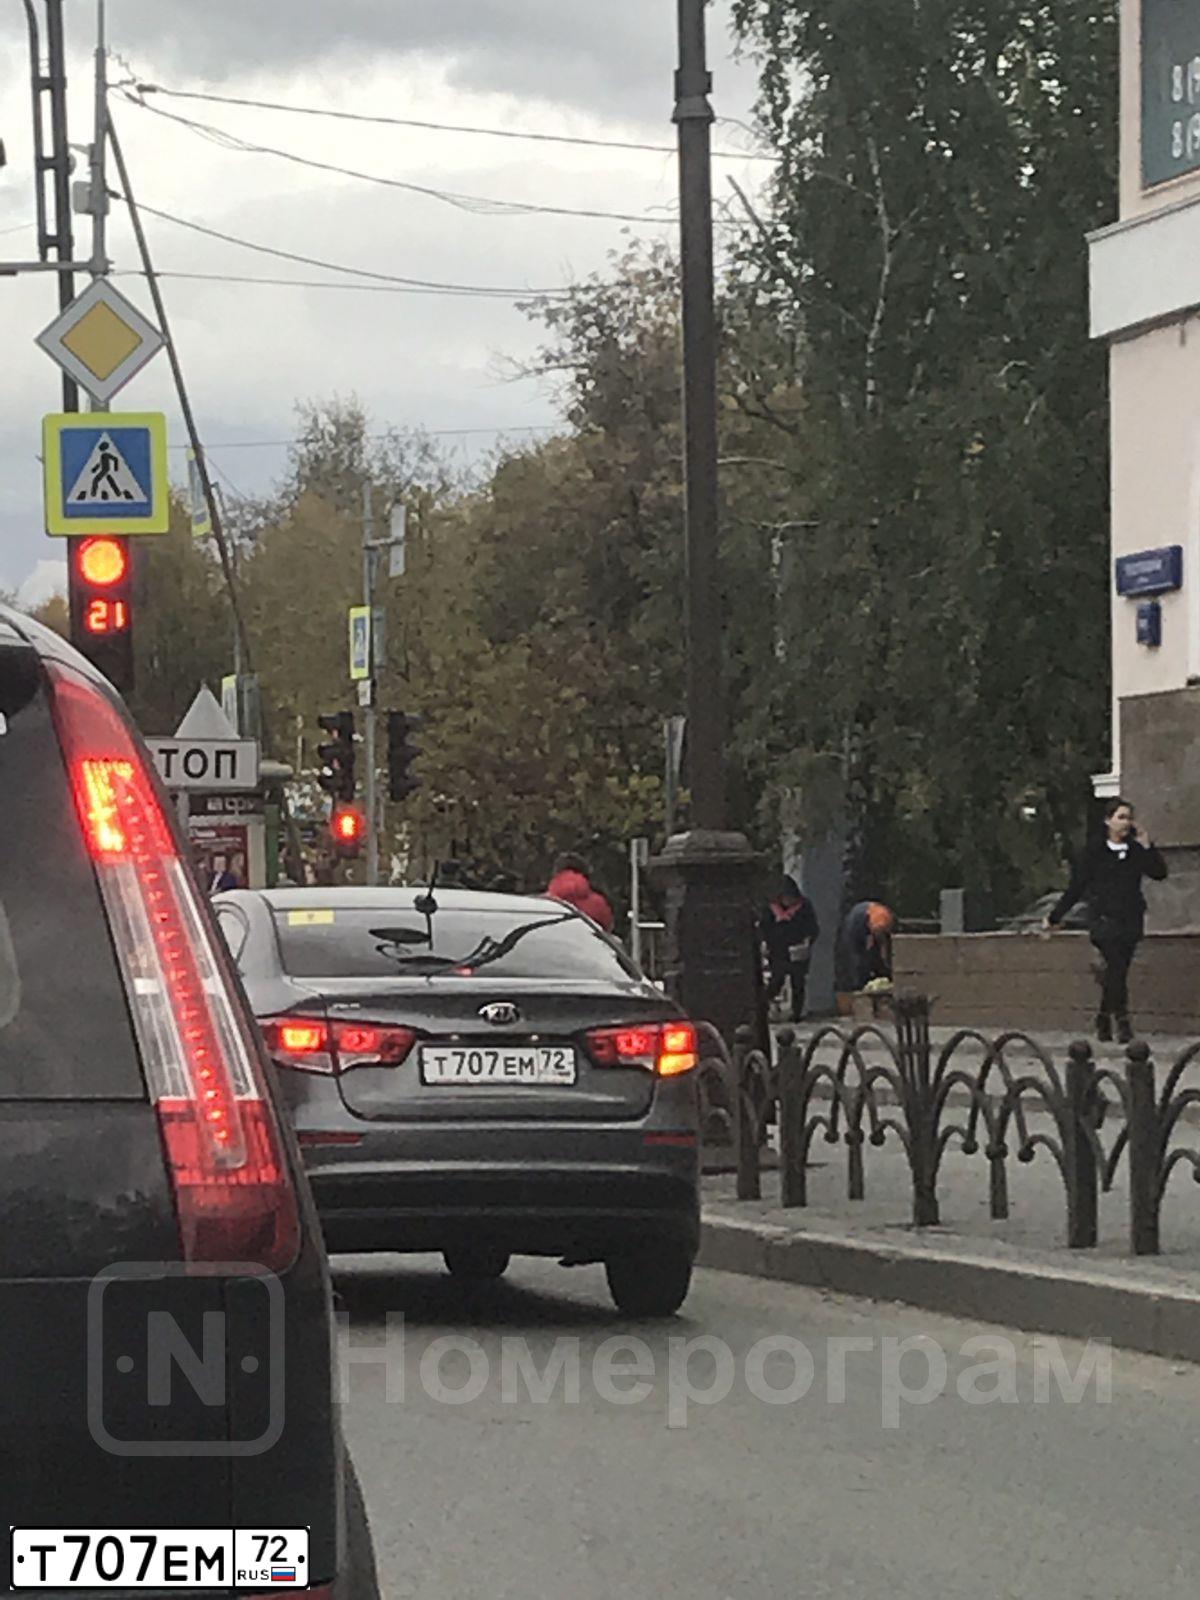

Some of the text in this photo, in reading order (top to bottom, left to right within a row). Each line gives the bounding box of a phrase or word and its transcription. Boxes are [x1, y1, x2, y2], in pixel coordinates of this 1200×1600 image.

[89, 600, 125, 629] 21
[158, 748, 237, 779] ТОП
[434, 1050, 565, 1076] Т707ЕМ 72
